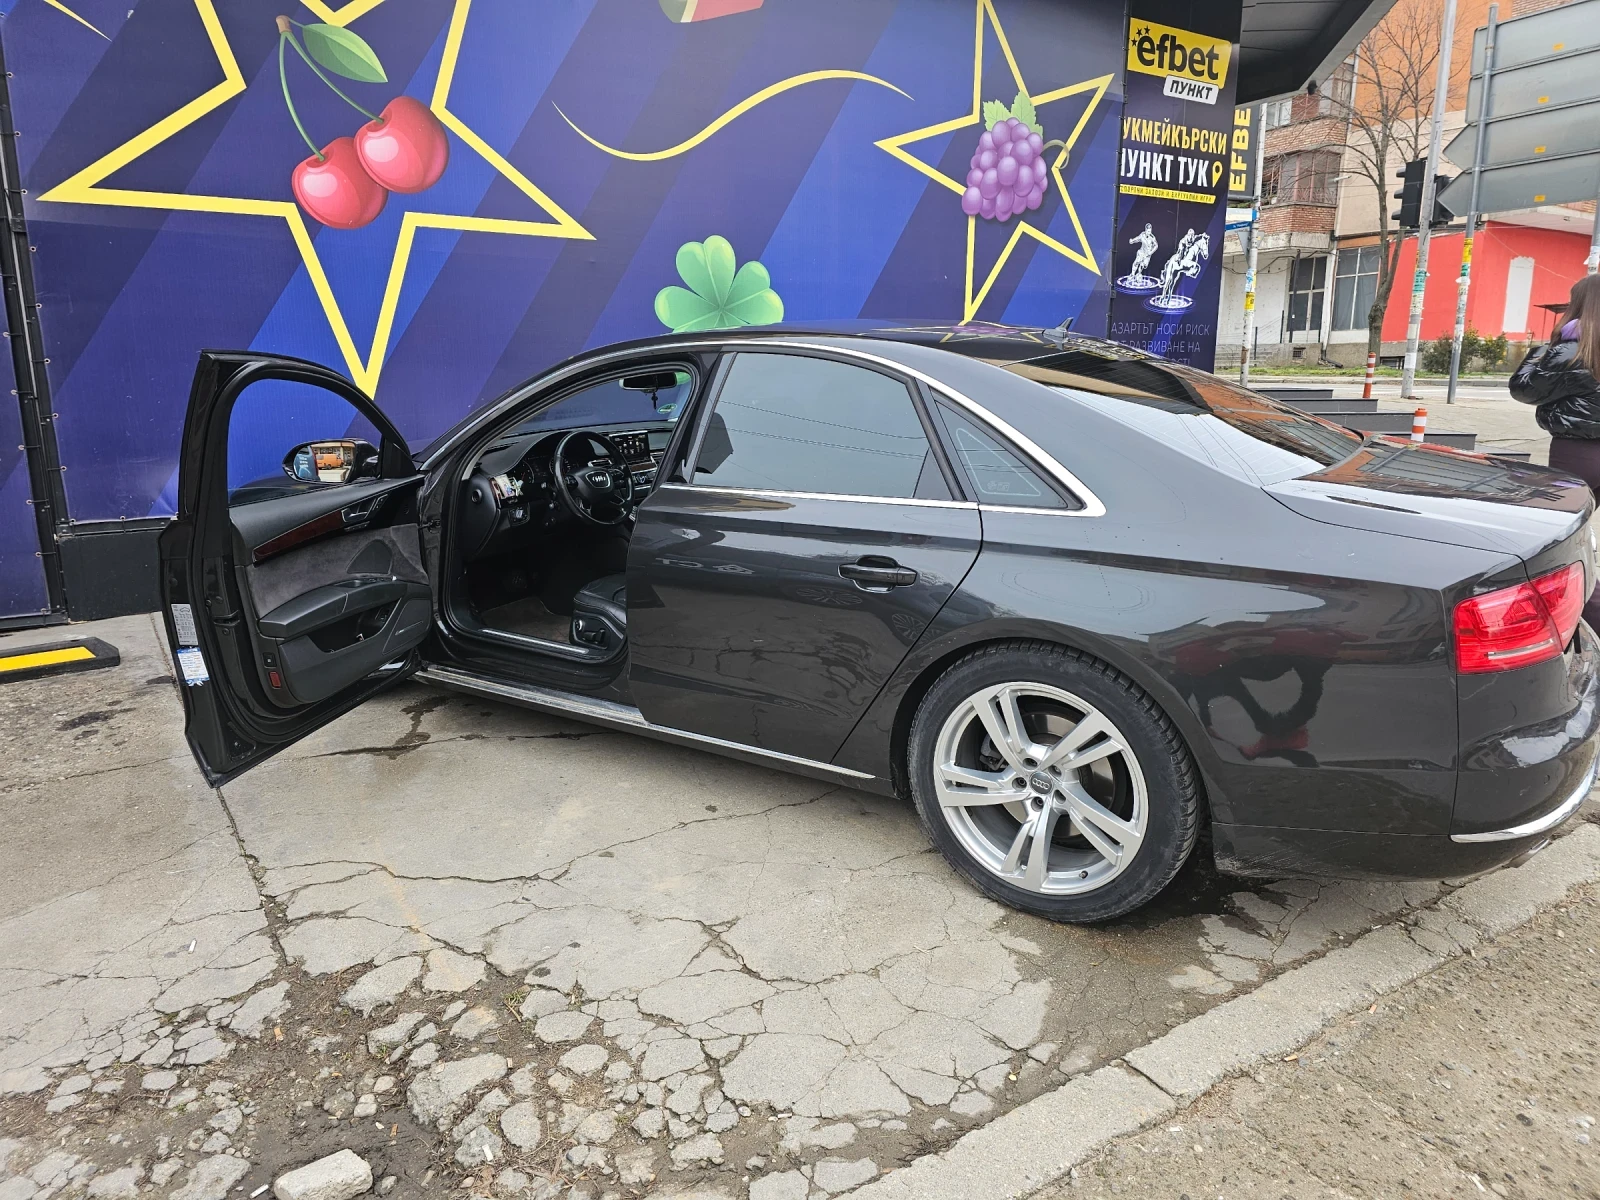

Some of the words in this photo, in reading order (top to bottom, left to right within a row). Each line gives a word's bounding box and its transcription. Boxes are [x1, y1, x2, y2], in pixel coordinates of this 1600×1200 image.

[1136, 33, 1219, 80] efbet
[1169, 79, 1213, 100] ПУНКТ
[1178, 156, 1210, 187] ТУК
[1111, 322, 1154, 334] АЗАРТЪТ
[1156, 323, 1182, 335] НОСИ
[1185, 323, 1210, 336] РИСК
[1187, 341, 1201, 353] НА
